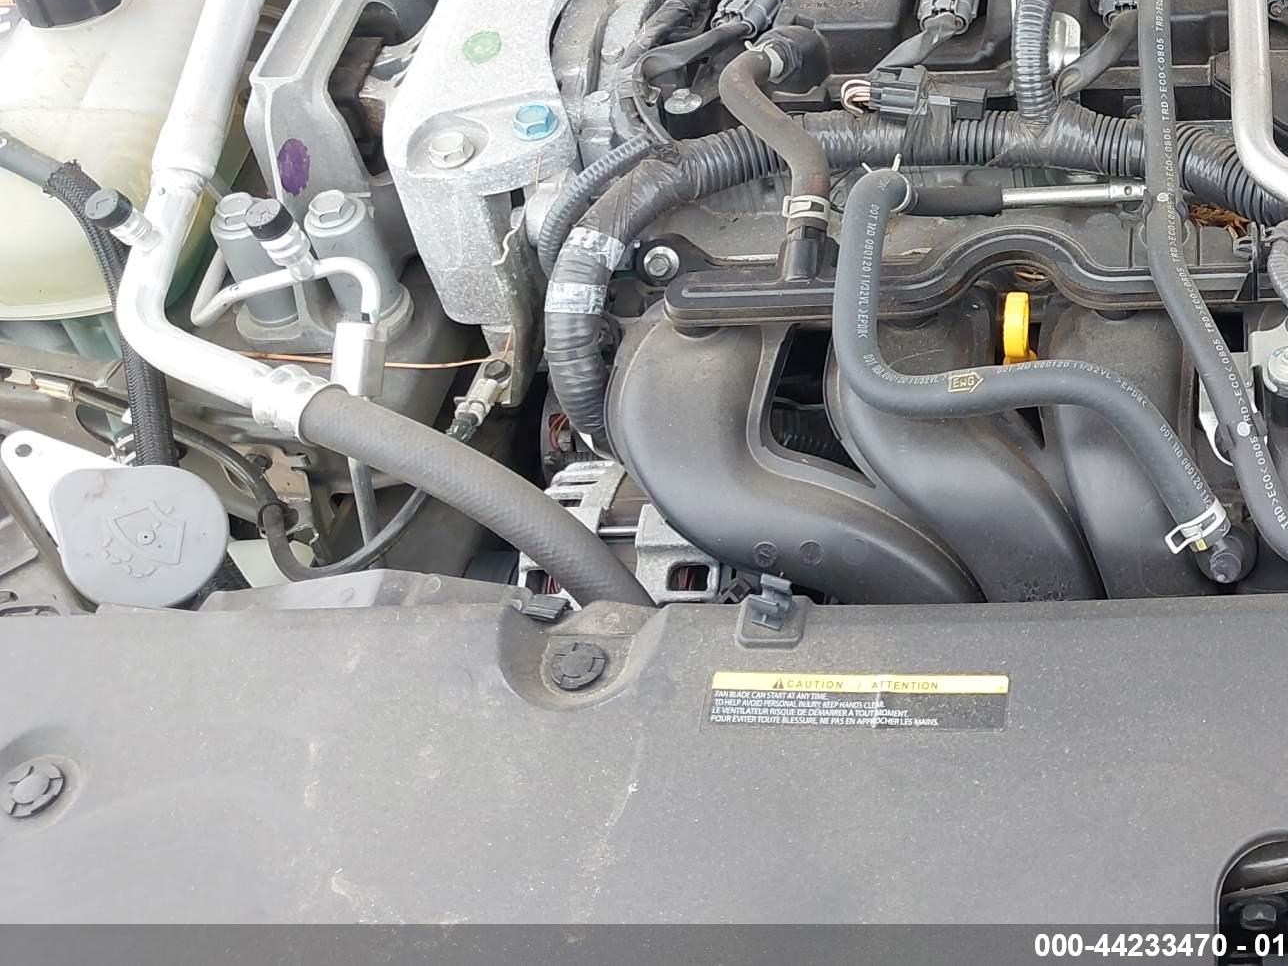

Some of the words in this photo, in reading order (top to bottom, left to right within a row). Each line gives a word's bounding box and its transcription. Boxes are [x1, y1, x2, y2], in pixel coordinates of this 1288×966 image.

[1156, 38, 1170, 121] TRD>ECO<0805
[1250, 436, 1288, 530] TRD>ECO<0805
[787, 680, 844, 689] CAUTION
[872, 681, 938, 690] ATTENTION
[725, 699, 741, 707] HELP
[742, 699, 762, 707] AVOID
[722, 707, 769, 715] VENTILATEUR
[770, 708, 796, 716] RISQUE
